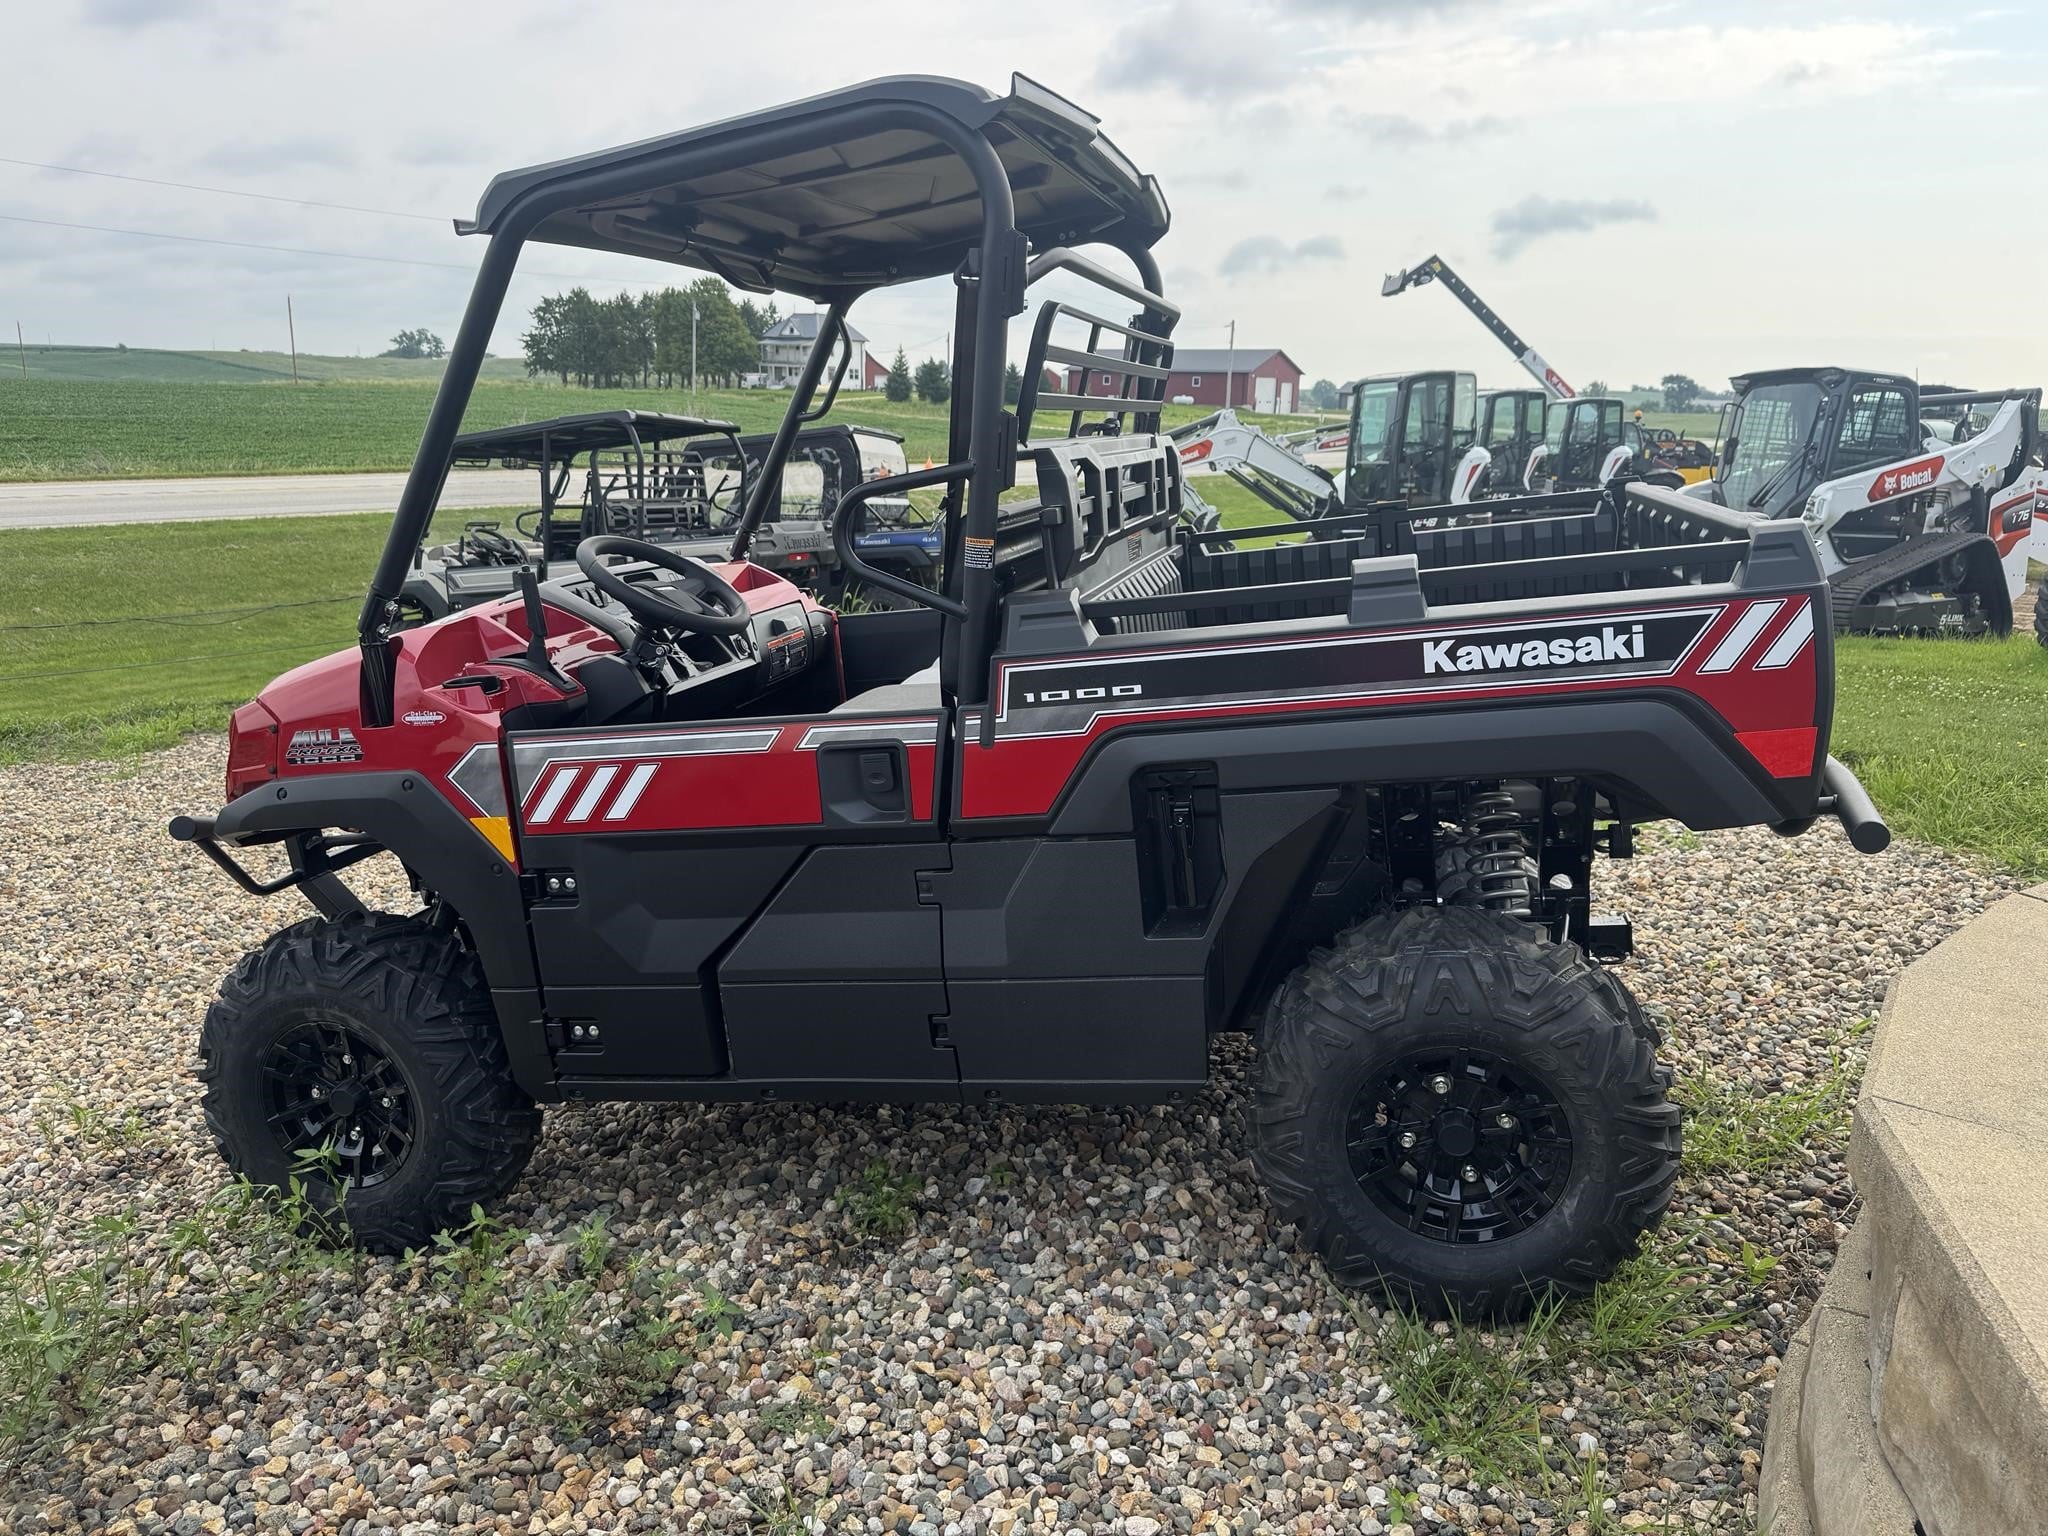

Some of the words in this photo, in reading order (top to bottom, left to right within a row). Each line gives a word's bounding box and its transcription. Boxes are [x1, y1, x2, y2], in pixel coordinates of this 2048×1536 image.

[1900, 467, 1933, 490] Bobcat
[2012, 508, 2030, 524] T76
[860, 536, 891, 546] Kawasaki
[1423, 624, 1645, 674] Kawasaki
[1024, 684, 1142, 703] 1000
[289, 728, 361, 749] MULE
[286, 745, 363, 758] PRO-FXR
